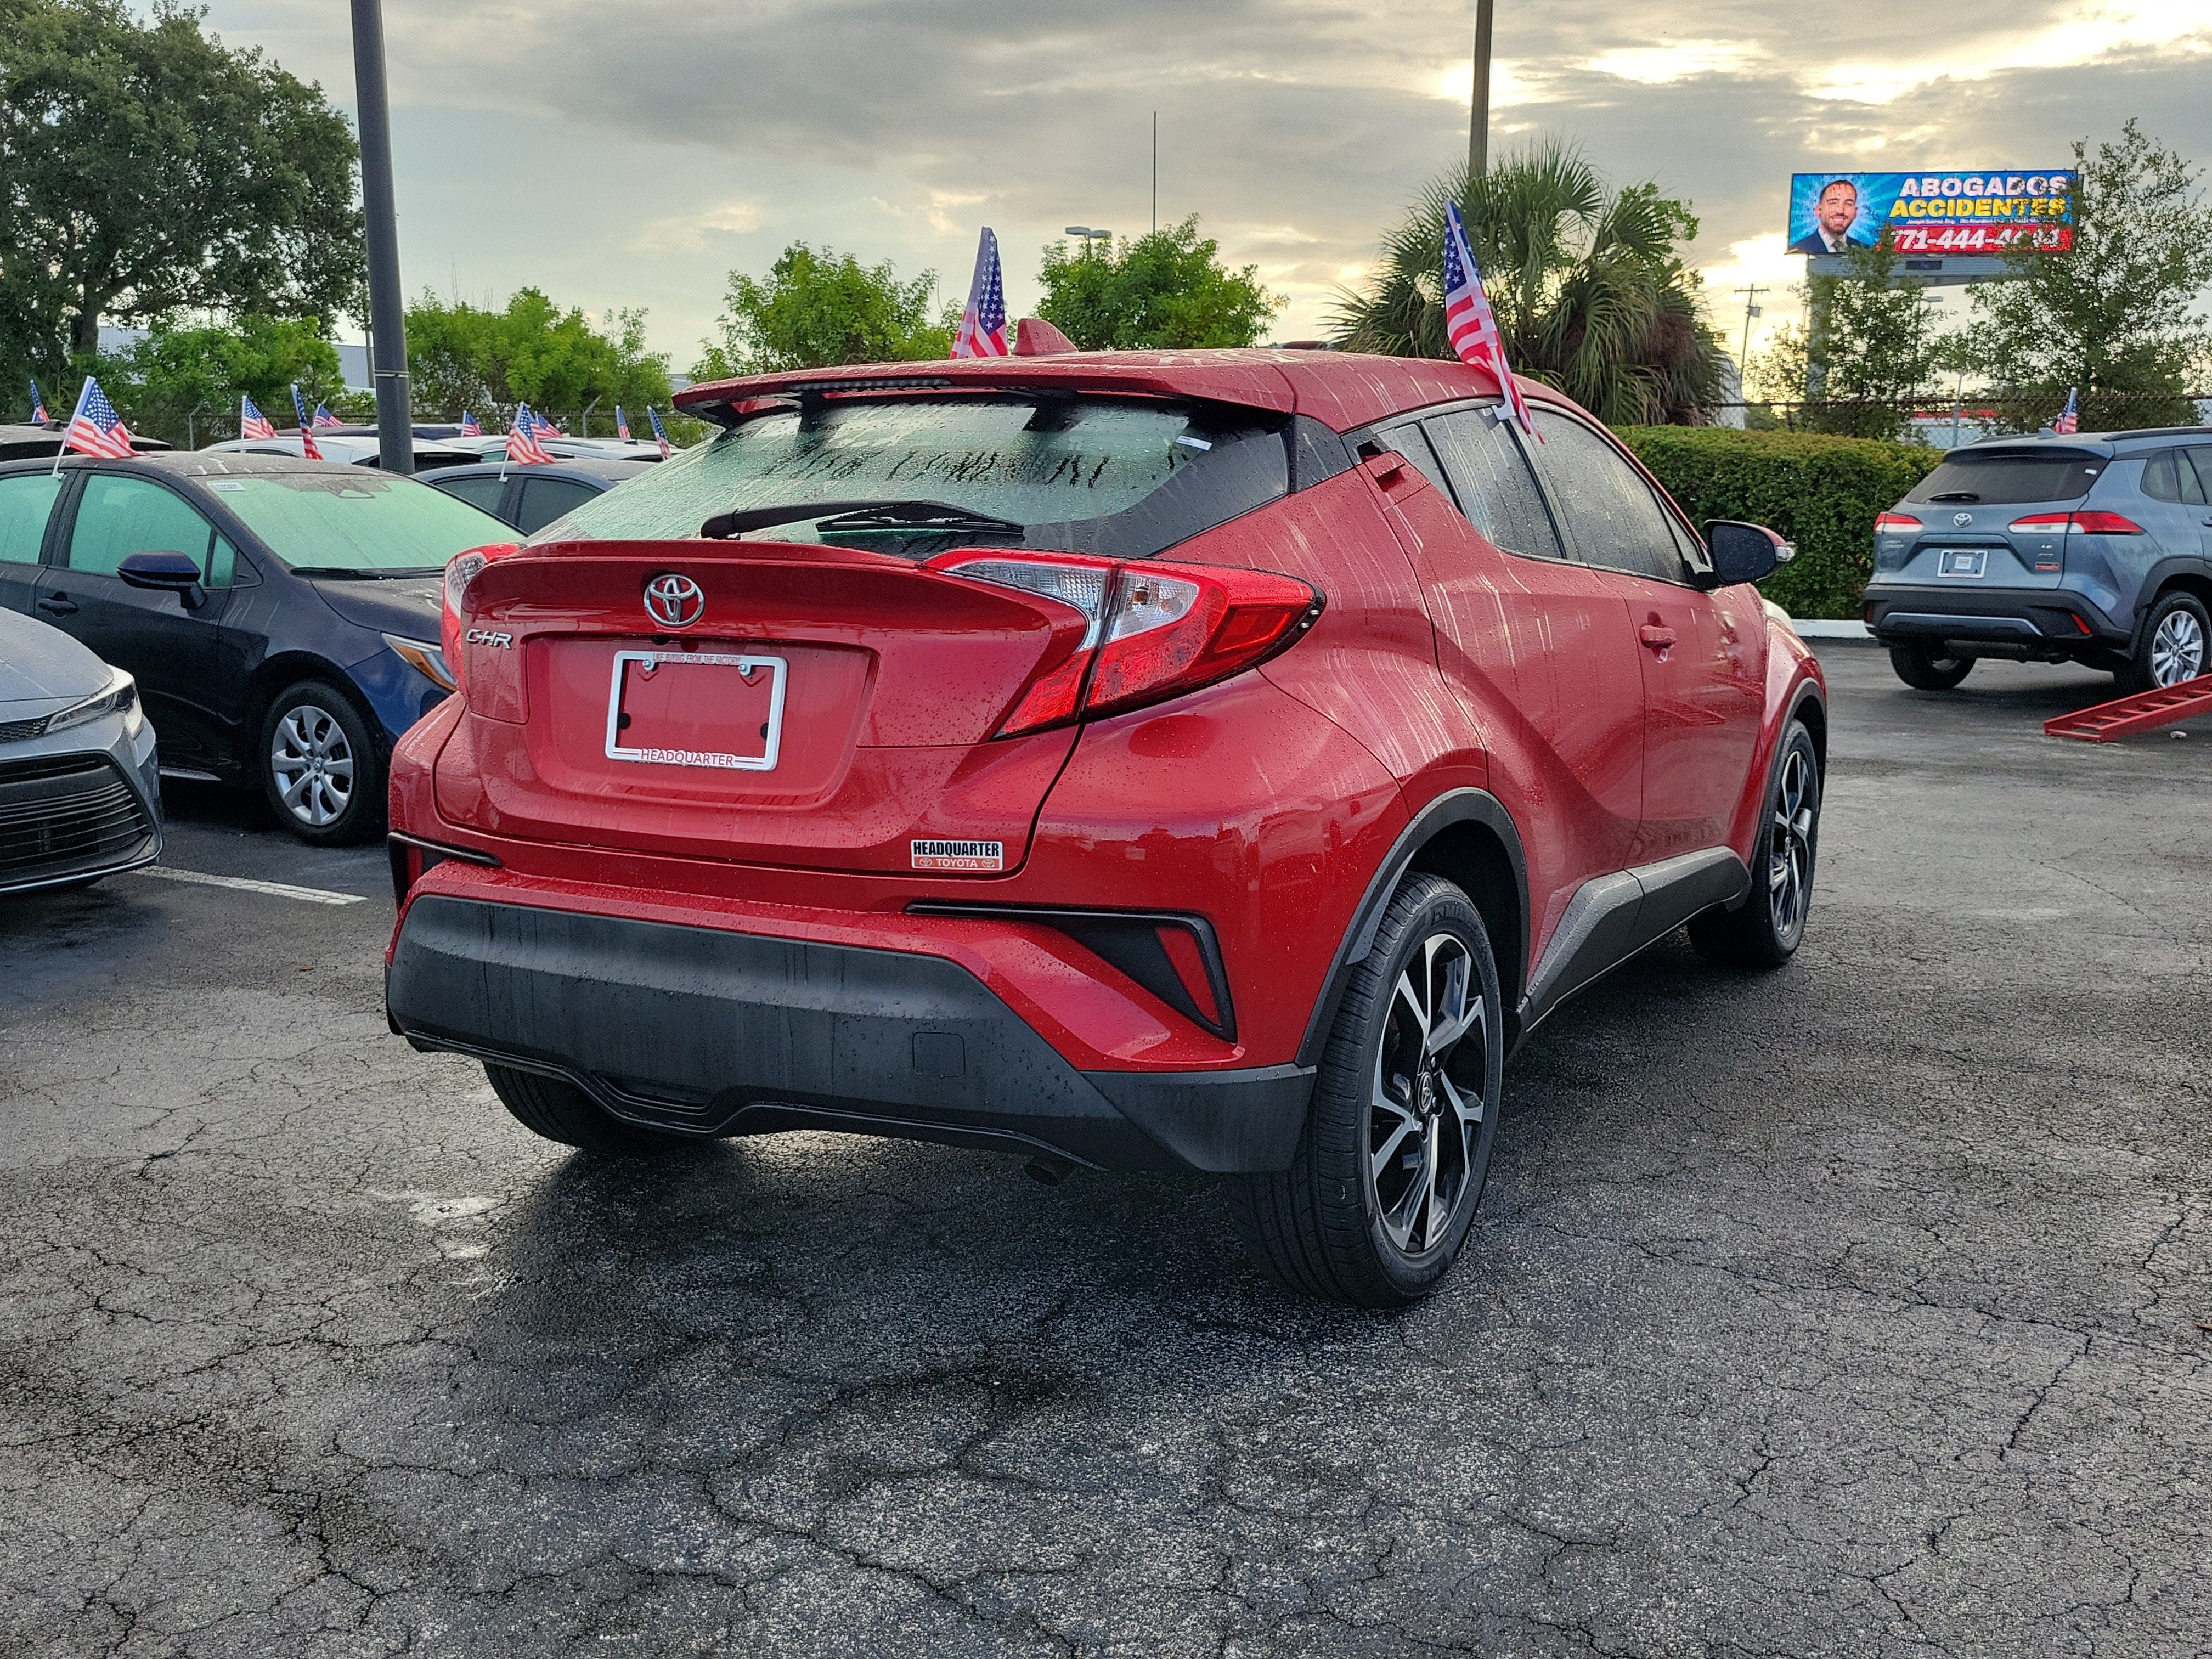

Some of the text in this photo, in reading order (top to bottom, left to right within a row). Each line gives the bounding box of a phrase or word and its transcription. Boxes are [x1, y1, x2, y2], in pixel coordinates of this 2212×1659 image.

[1899, 176, 2067, 197] ABOGADOS
[1889, 198, 2066, 217] ACCIDENTES
[641, 749, 734, 766] HEADQUARTER
[913, 842, 1000, 857] HEADQUARTER
[936, 859, 978, 867] TOYOTA
